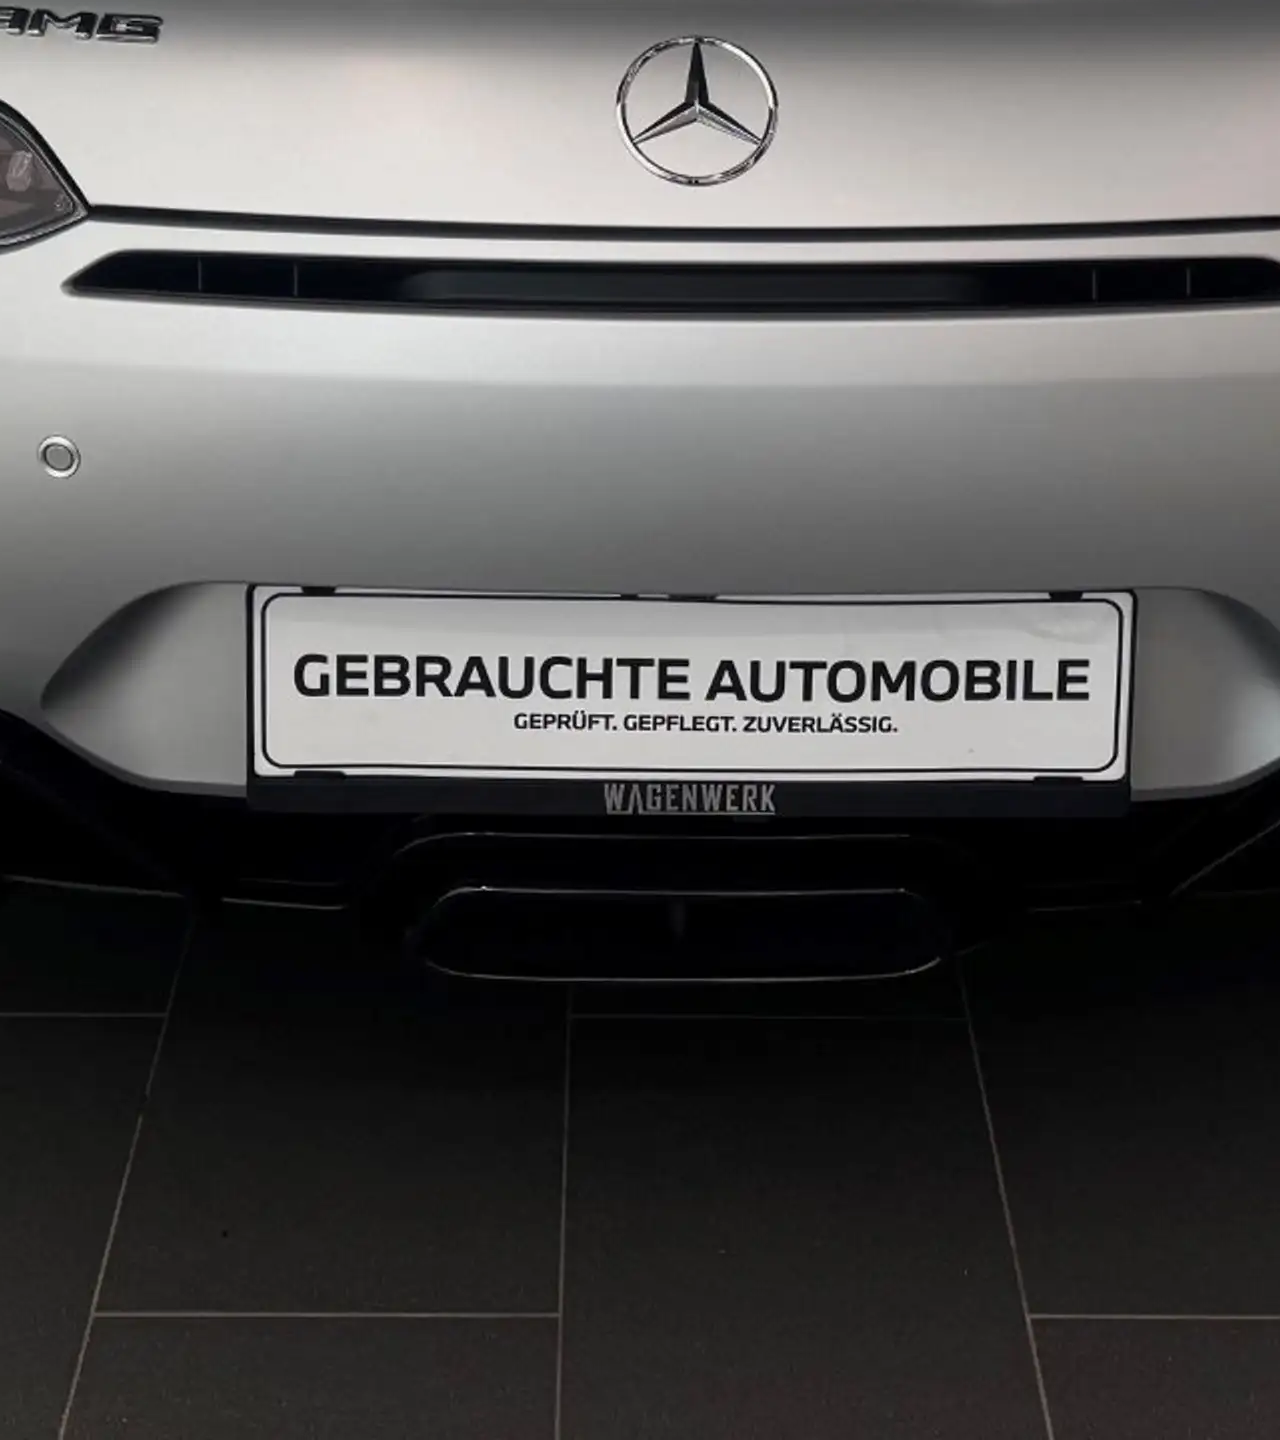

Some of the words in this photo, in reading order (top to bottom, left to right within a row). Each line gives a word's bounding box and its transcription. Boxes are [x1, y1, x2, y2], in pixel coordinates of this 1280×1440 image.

[293, 653, 691, 700] GEBRAUCHTE
[704, 658, 1091, 702] AUTOMOBILE
[513, 710, 618, 732] GEPRÜFT.
[623, 714, 737, 733] GEPFLEGT.
[742, 712, 899, 733] ZUVERLÄSSIG.
[604, 782, 776, 815] WAGENWERK
